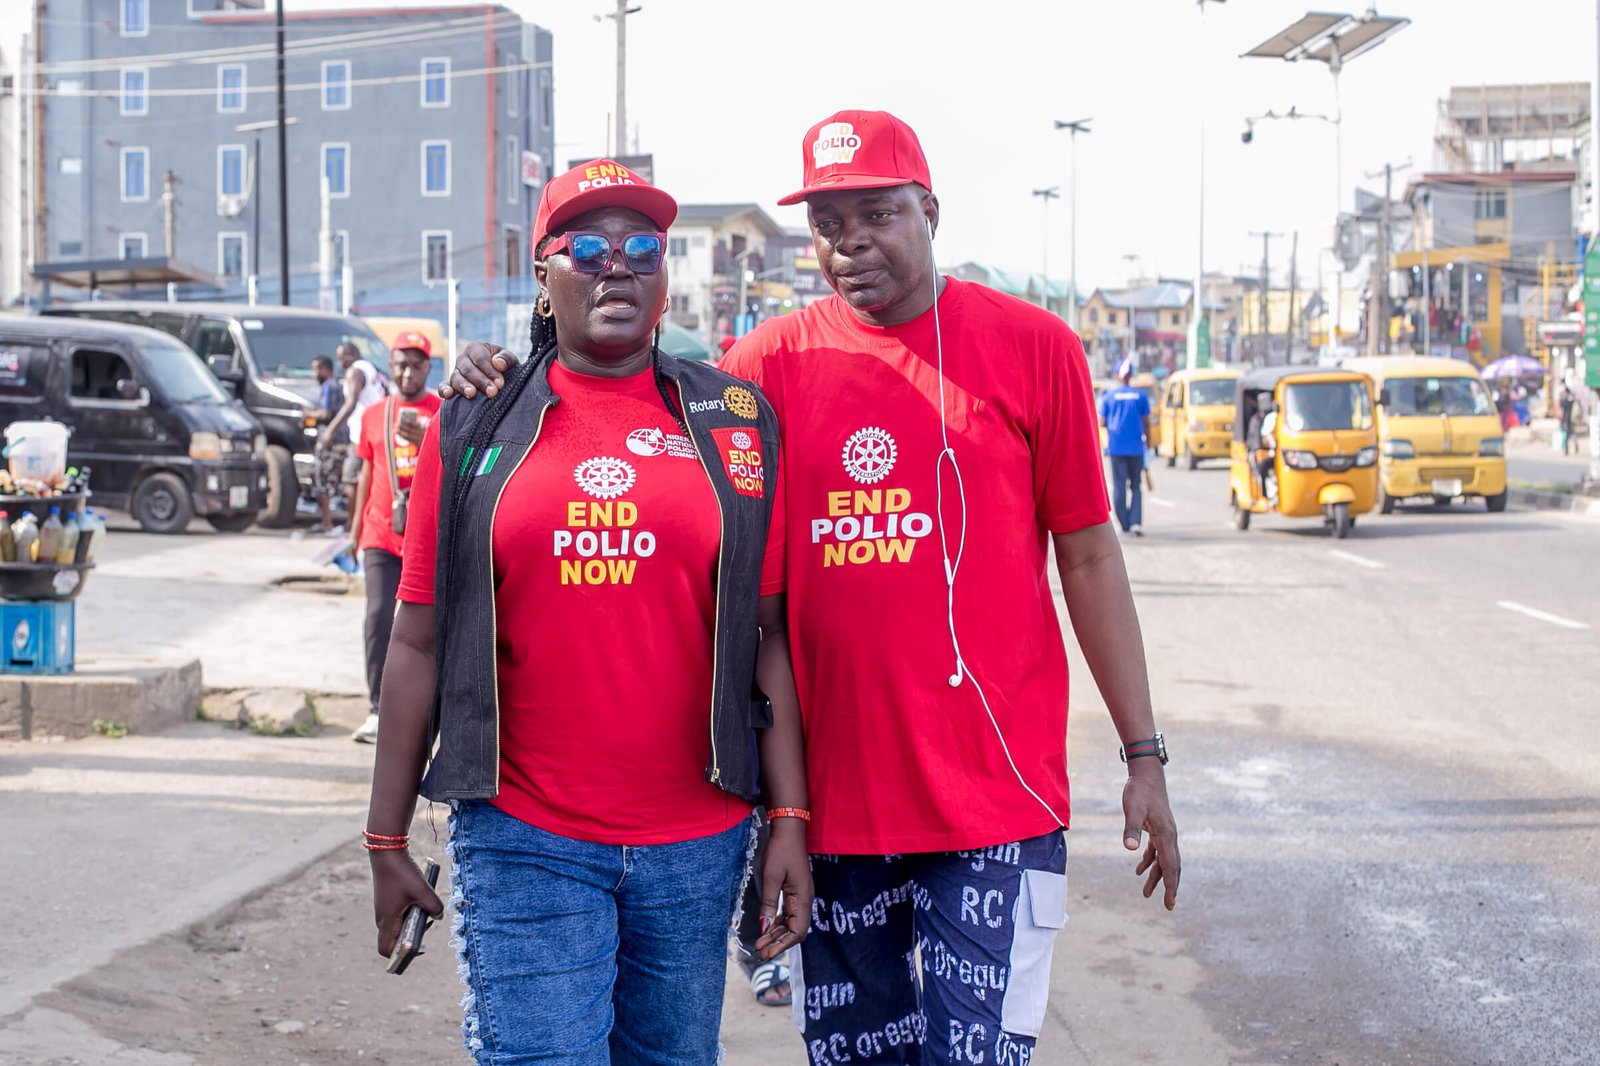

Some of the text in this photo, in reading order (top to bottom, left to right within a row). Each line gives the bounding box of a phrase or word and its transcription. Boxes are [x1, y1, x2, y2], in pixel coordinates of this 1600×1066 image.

[814, 136, 859, 155] POLIO
[585, 163, 630, 180] END
[688, 399, 726, 413] Rotary
[728, 450, 761, 466] END
[734, 477, 763, 491] NOW
[567, 501, 638, 527] END
[828, 487, 911, 516] END
[811, 512, 933, 543] POLIO
[553, 529, 657, 557] POLIO
[823, 538, 916, 567] NOW
[560, 559, 637, 585] NOW
[961, 886, 1004, 928] RC
[810, 1032, 851, 1066] RC
[949, 1018, 986, 1065] RC
